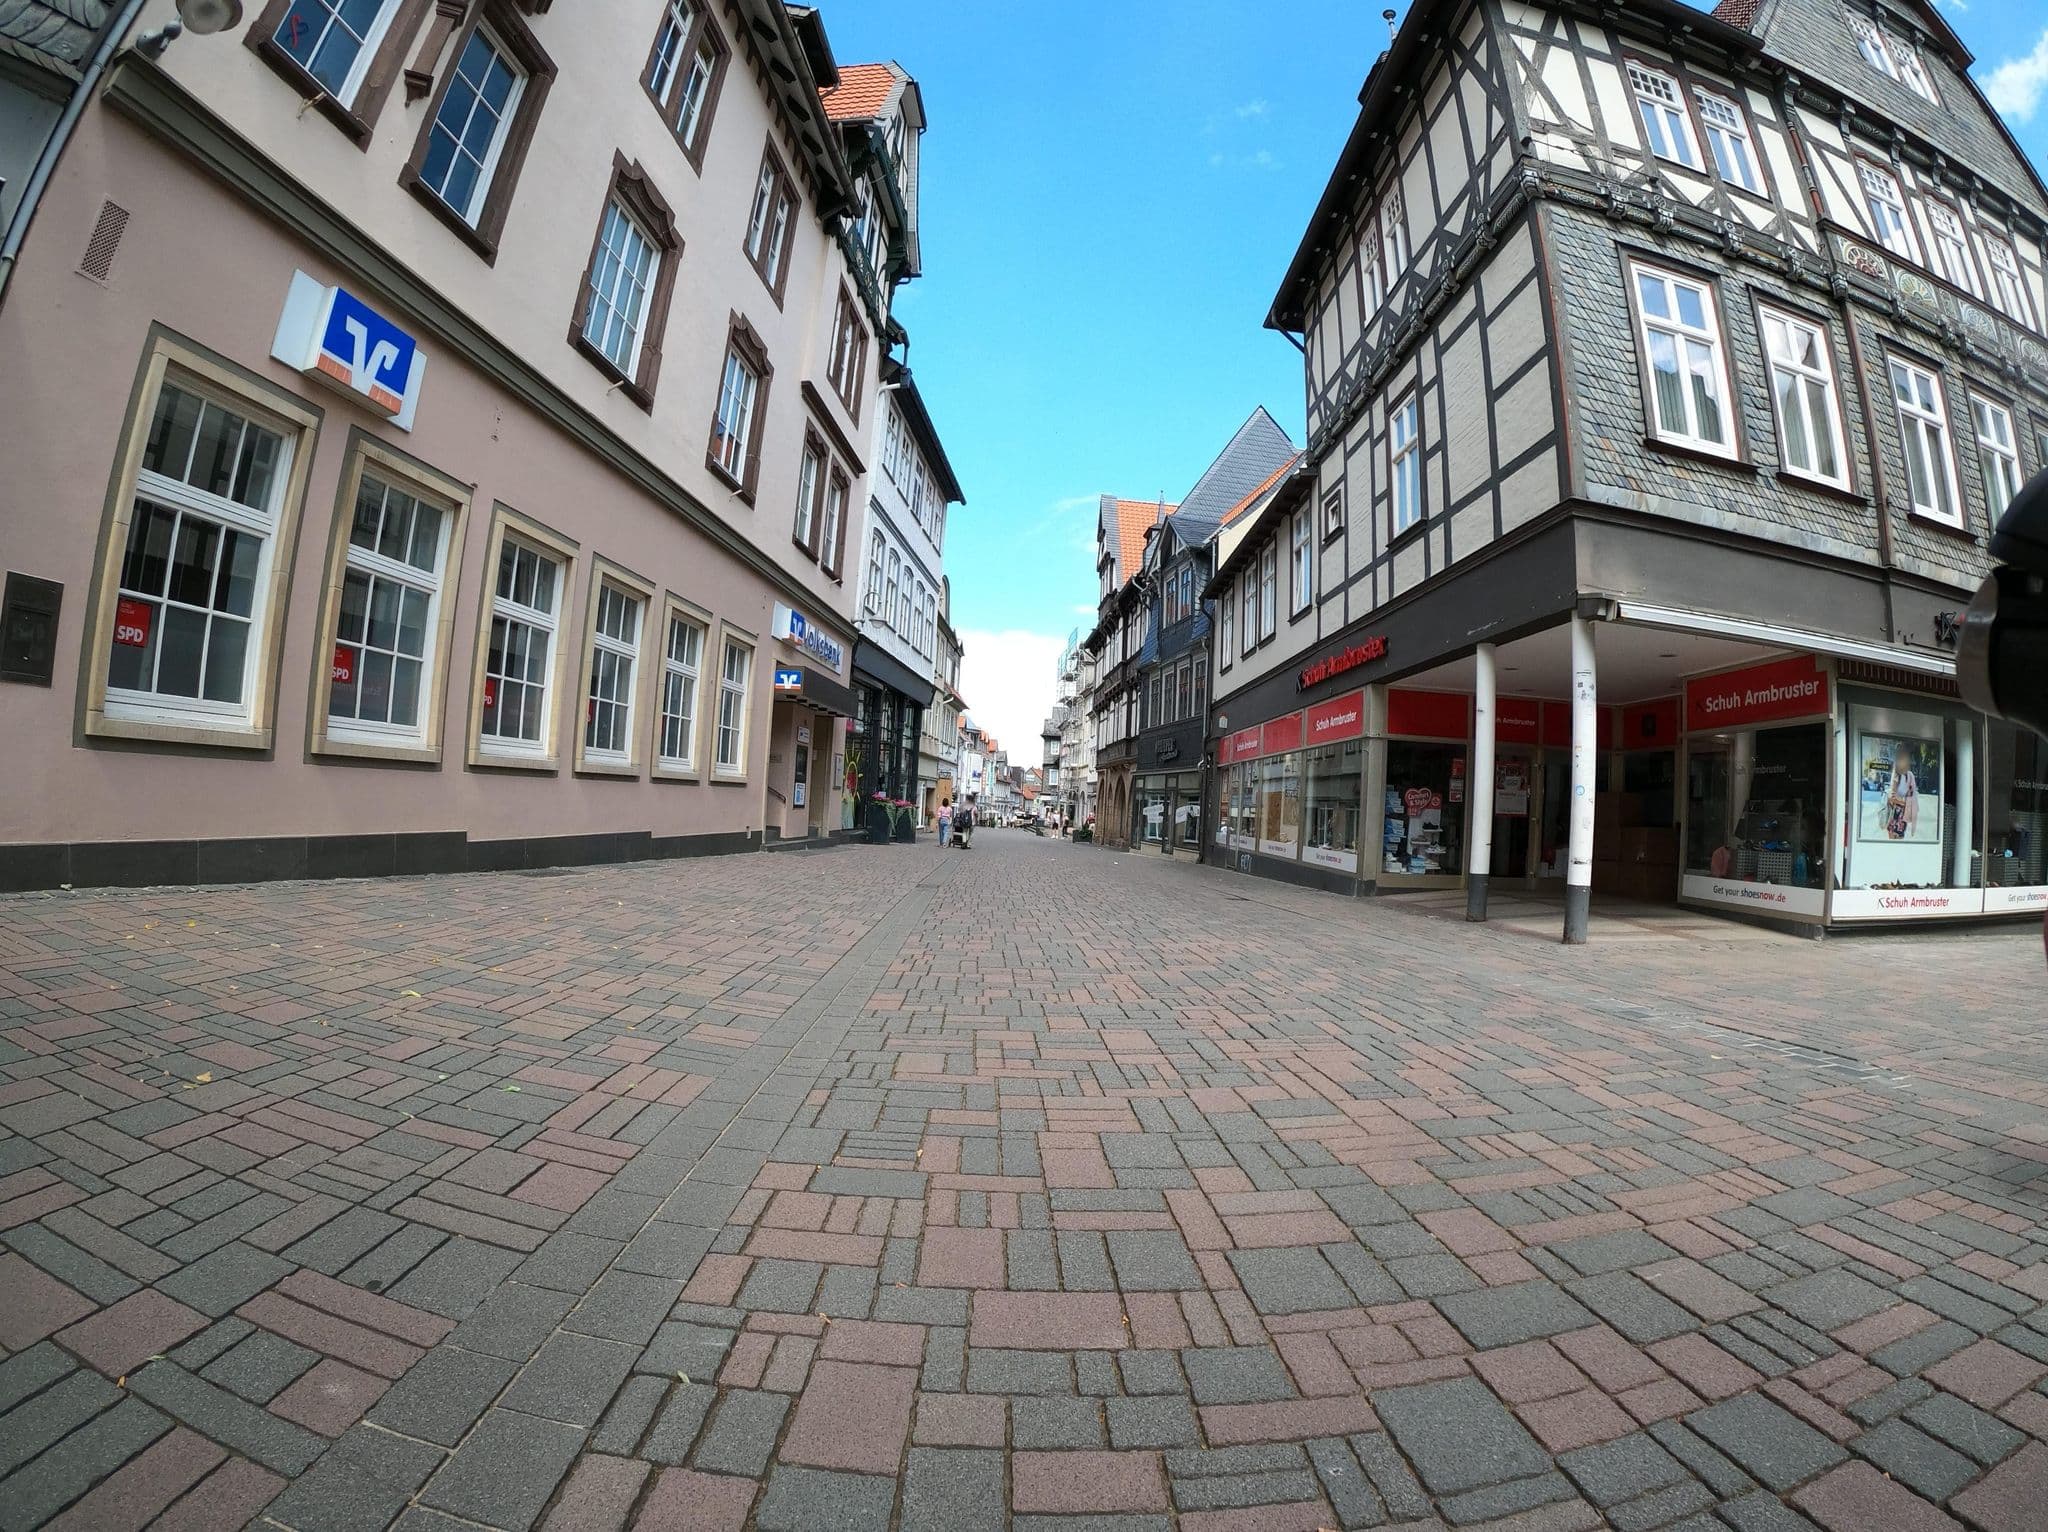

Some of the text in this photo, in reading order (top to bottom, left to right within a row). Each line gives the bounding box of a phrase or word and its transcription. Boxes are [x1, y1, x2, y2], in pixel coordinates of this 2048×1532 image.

[117, 625, 144, 643] SPD
[332, 666, 349, 680] SPD
[1705, 679, 1820, 713] Schuh Armbruster
[1315, 711, 1357, 731] Schuh Armbruster
[1713, 885, 1724, 894] Get
[1725, 888, 1739, 897] your
[1885, 896, 1950, 908] Schuh Armbruster
